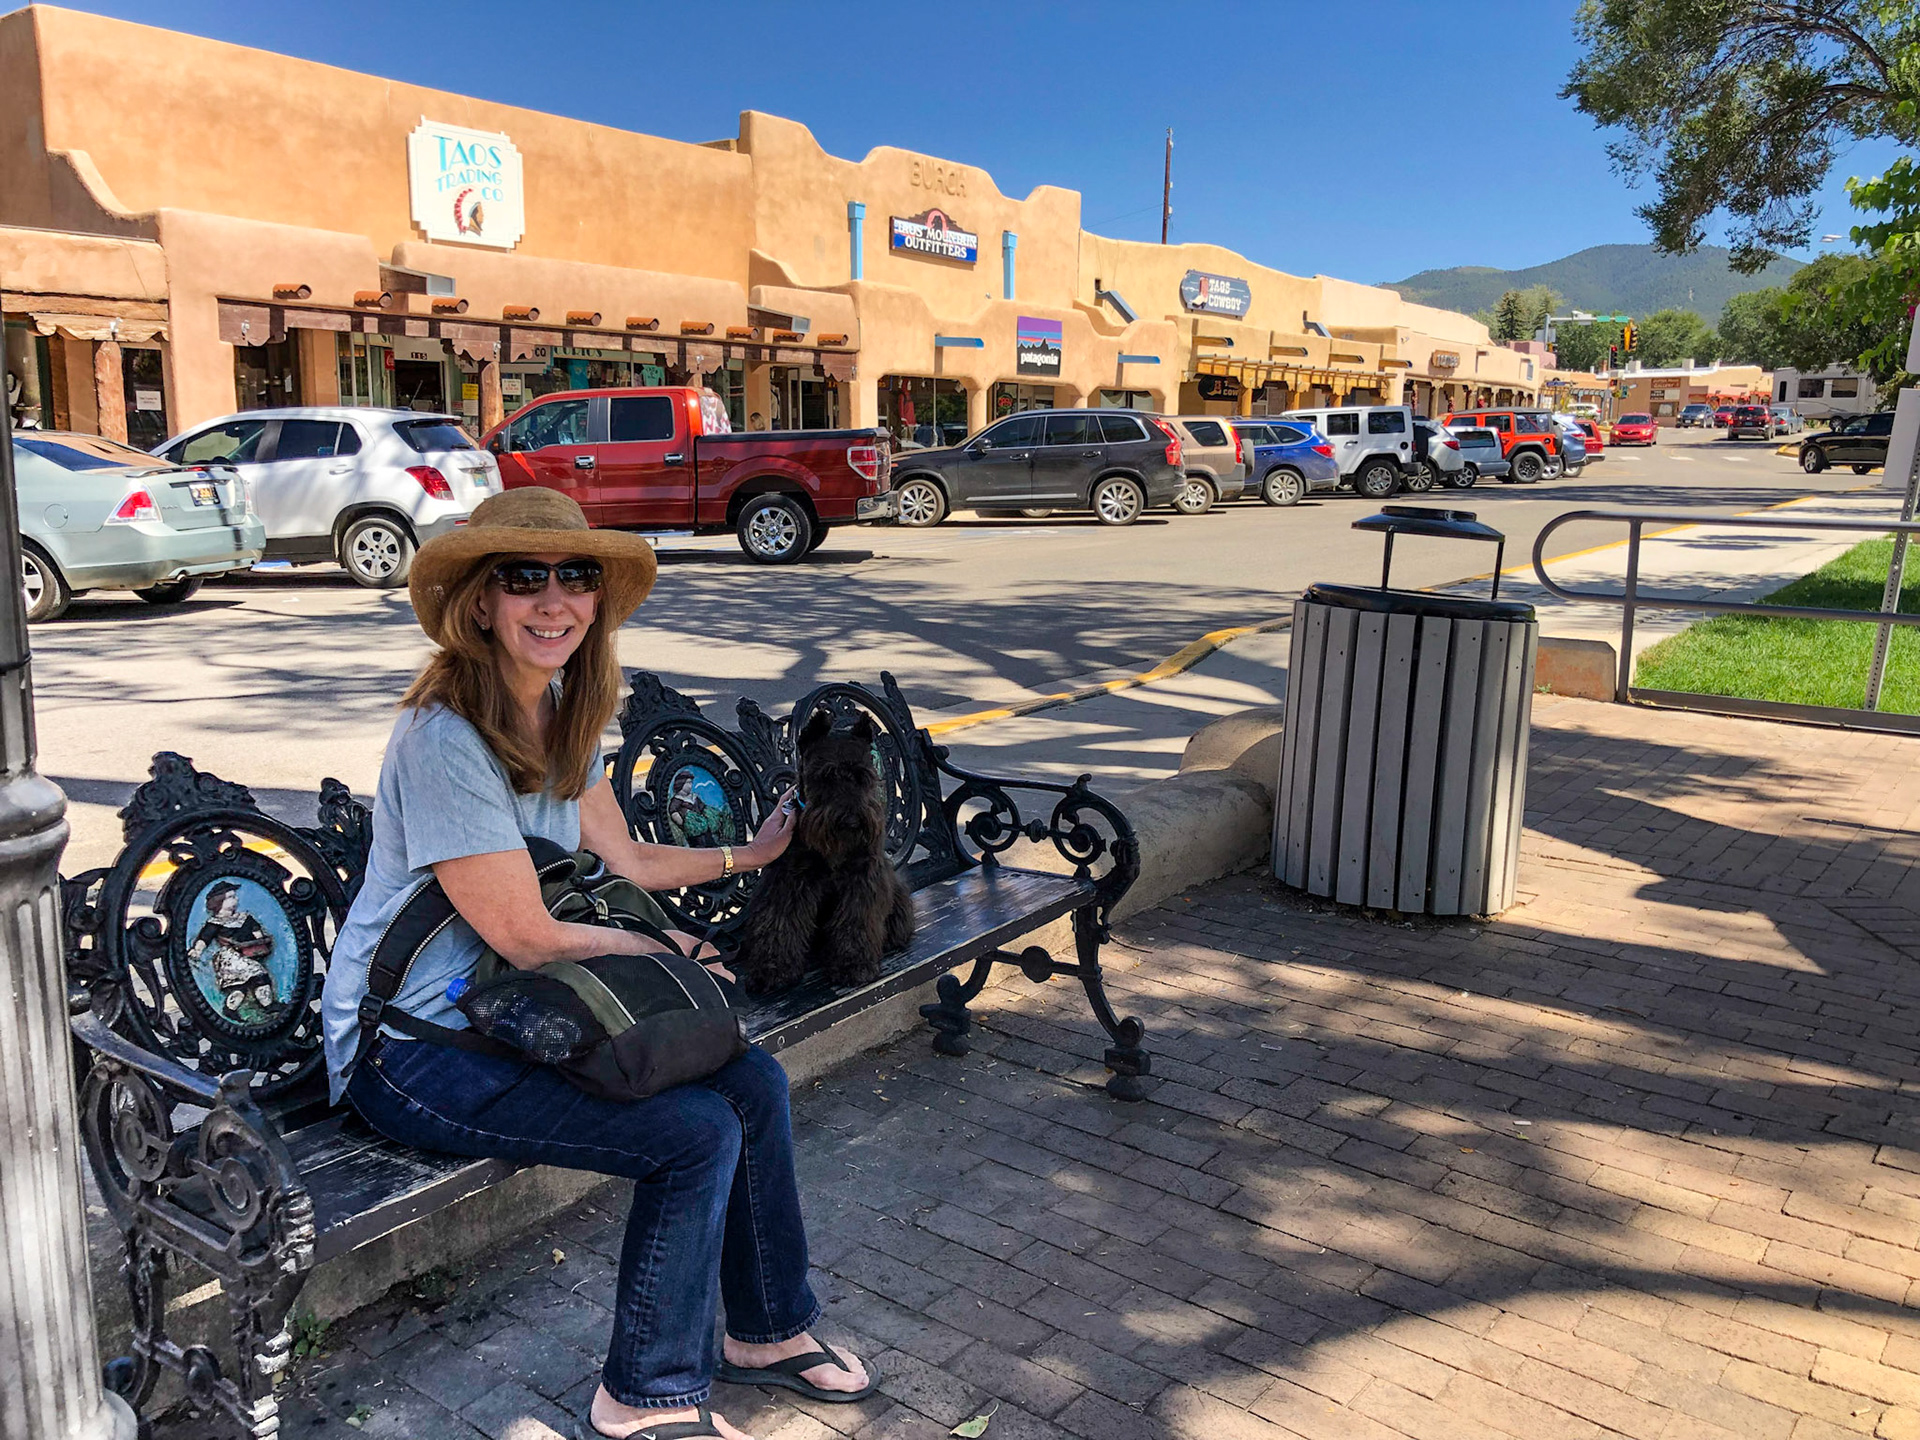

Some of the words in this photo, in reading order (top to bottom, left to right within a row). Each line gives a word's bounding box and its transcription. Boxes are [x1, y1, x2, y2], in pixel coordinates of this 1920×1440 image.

[432, 135, 502, 172] TAOS
[434, 169, 502, 193] TRADING
[910, 160, 967, 198] BURCH
[481, 186, 504, 202] CO
[895, 221, 923, 238] TAOS
[926, 228, 977, 249] MOUNTAIN
[904, 236, 968, 259] OUTFITTERS
[1208, 278, 1231, 295] TAOS
[1208, 294, 1242, 311] COWBOY
[1020, 352, 1059, 367] patagonia
[1222, 388, 1239, 396] COW
